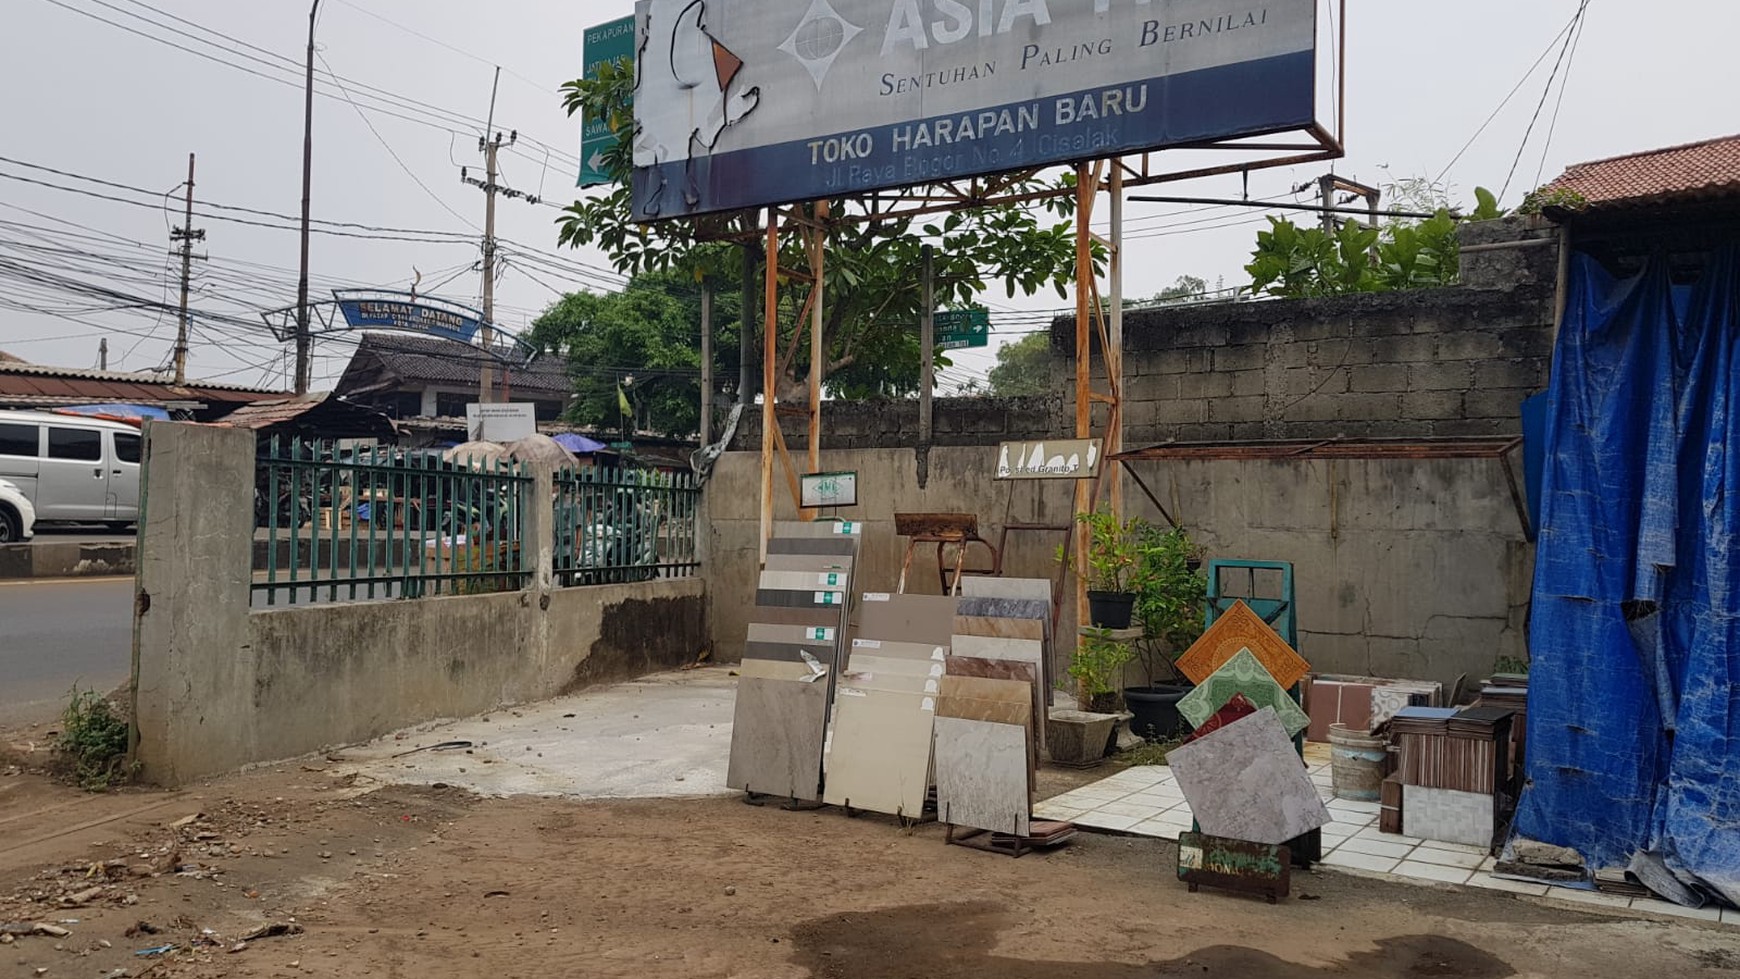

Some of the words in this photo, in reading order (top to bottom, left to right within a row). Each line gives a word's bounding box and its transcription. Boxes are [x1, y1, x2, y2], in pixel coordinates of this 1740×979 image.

[881, 0, 1051, 54] ASIA
[1020, 39, 1112, 70] PALING
[1139, 9, 1268, 47] BERNILAI
[807, 133, 873, 165] TOKO
[892, 102, 1039, 152] HARAPAN
[1055, 84, 1147, 125] BARU
[360, 302, 413, 315] SELAMAT
[421, 309, 463, 326] DATANG
[1038, 464, 1069, 473] Granito
